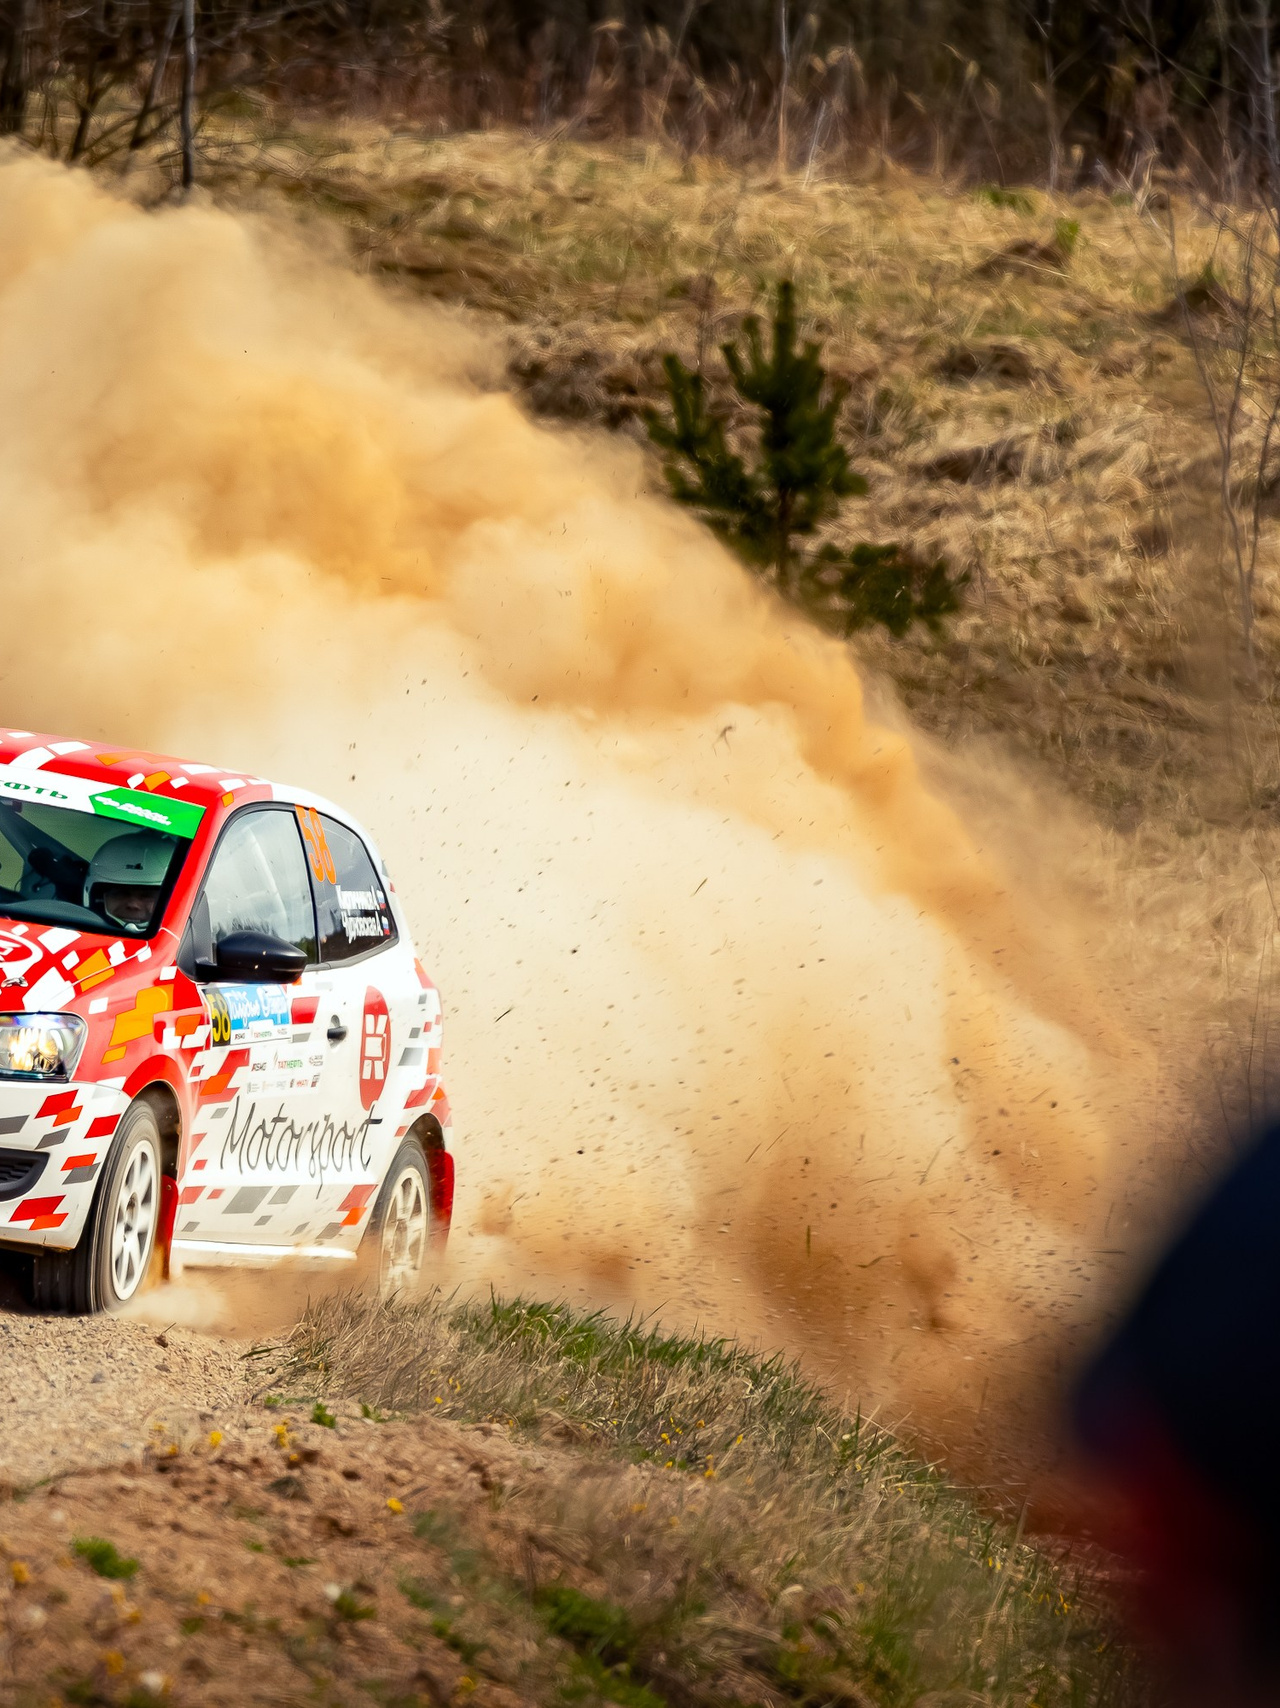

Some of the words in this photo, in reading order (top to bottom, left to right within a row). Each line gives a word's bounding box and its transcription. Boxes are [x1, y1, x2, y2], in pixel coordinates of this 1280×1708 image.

[295, 804, 336, 885] 58
[206, 993, 231, 1042] 58
[220, 1096, 383, 1199] Motorsport
